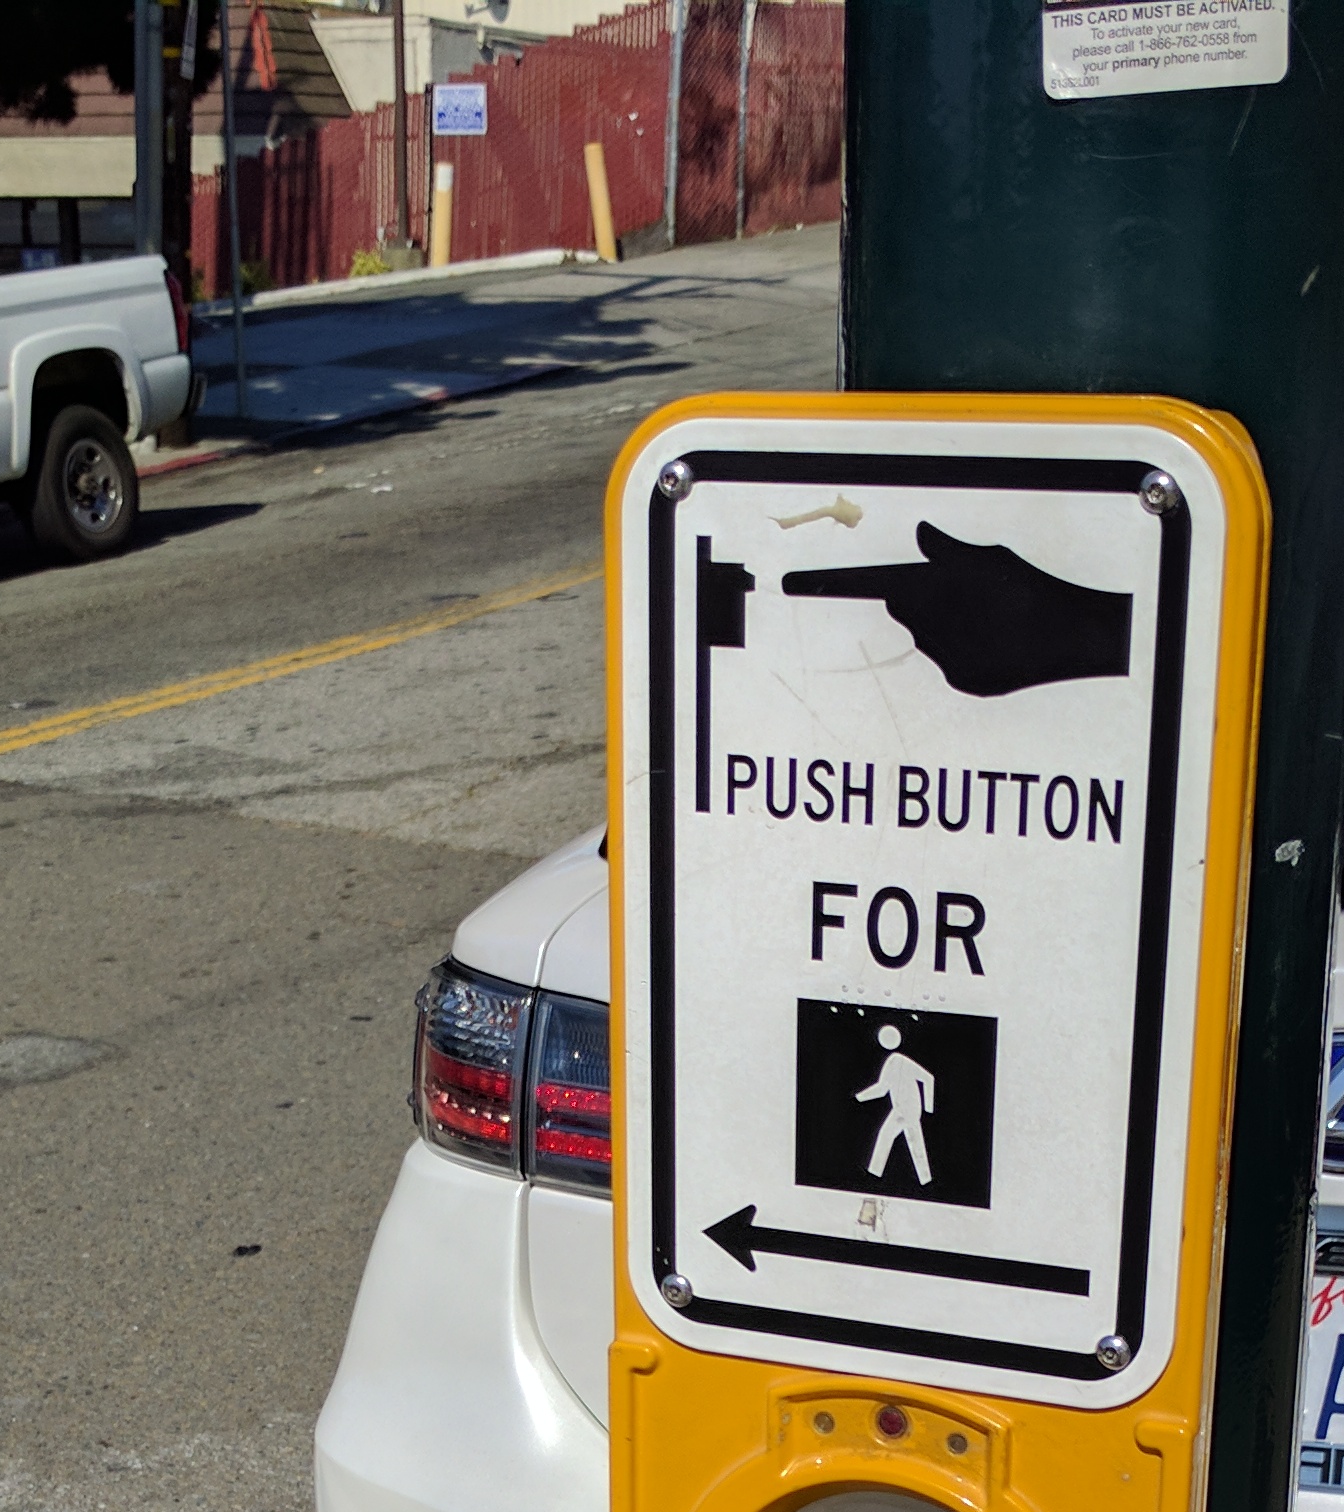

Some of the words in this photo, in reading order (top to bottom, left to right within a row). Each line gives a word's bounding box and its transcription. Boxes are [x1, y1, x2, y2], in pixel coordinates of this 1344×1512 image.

[1051, 12, 1084, 29] THIS
[1087, 8, 1128, 25] CARD
[1132, 4, 1173, 21] MUST
[1176, 2, 1196, 17] BE
[1199, 0, 1276, 15] ACTIVATED.
[1091, 27, 1105, 41] To
[1108, 24, 1154, 40] activate
[1156, 22, 1183, 37] your
[1185, 20, 1210, 32] new
[1212, 16, 1241, 31] card,
[1072, 43, 1112, 61] please
[1114, 39, 1135, 54] call
[1138, 31, 1230, 52] 1-866-762-0558
[1232, 31, 1258, 44] from
[1082, 60, 1109, 76] your
[1112, 56, 1161, 73] primary
[1163, 51, 1201, 68] phone
[1203, 48, 1248, 62] number.
[726, 753, 875, 826] PUSH
[896, 764, 1125, 845] BUTTON
[810, 880, 987, 976] FOR
